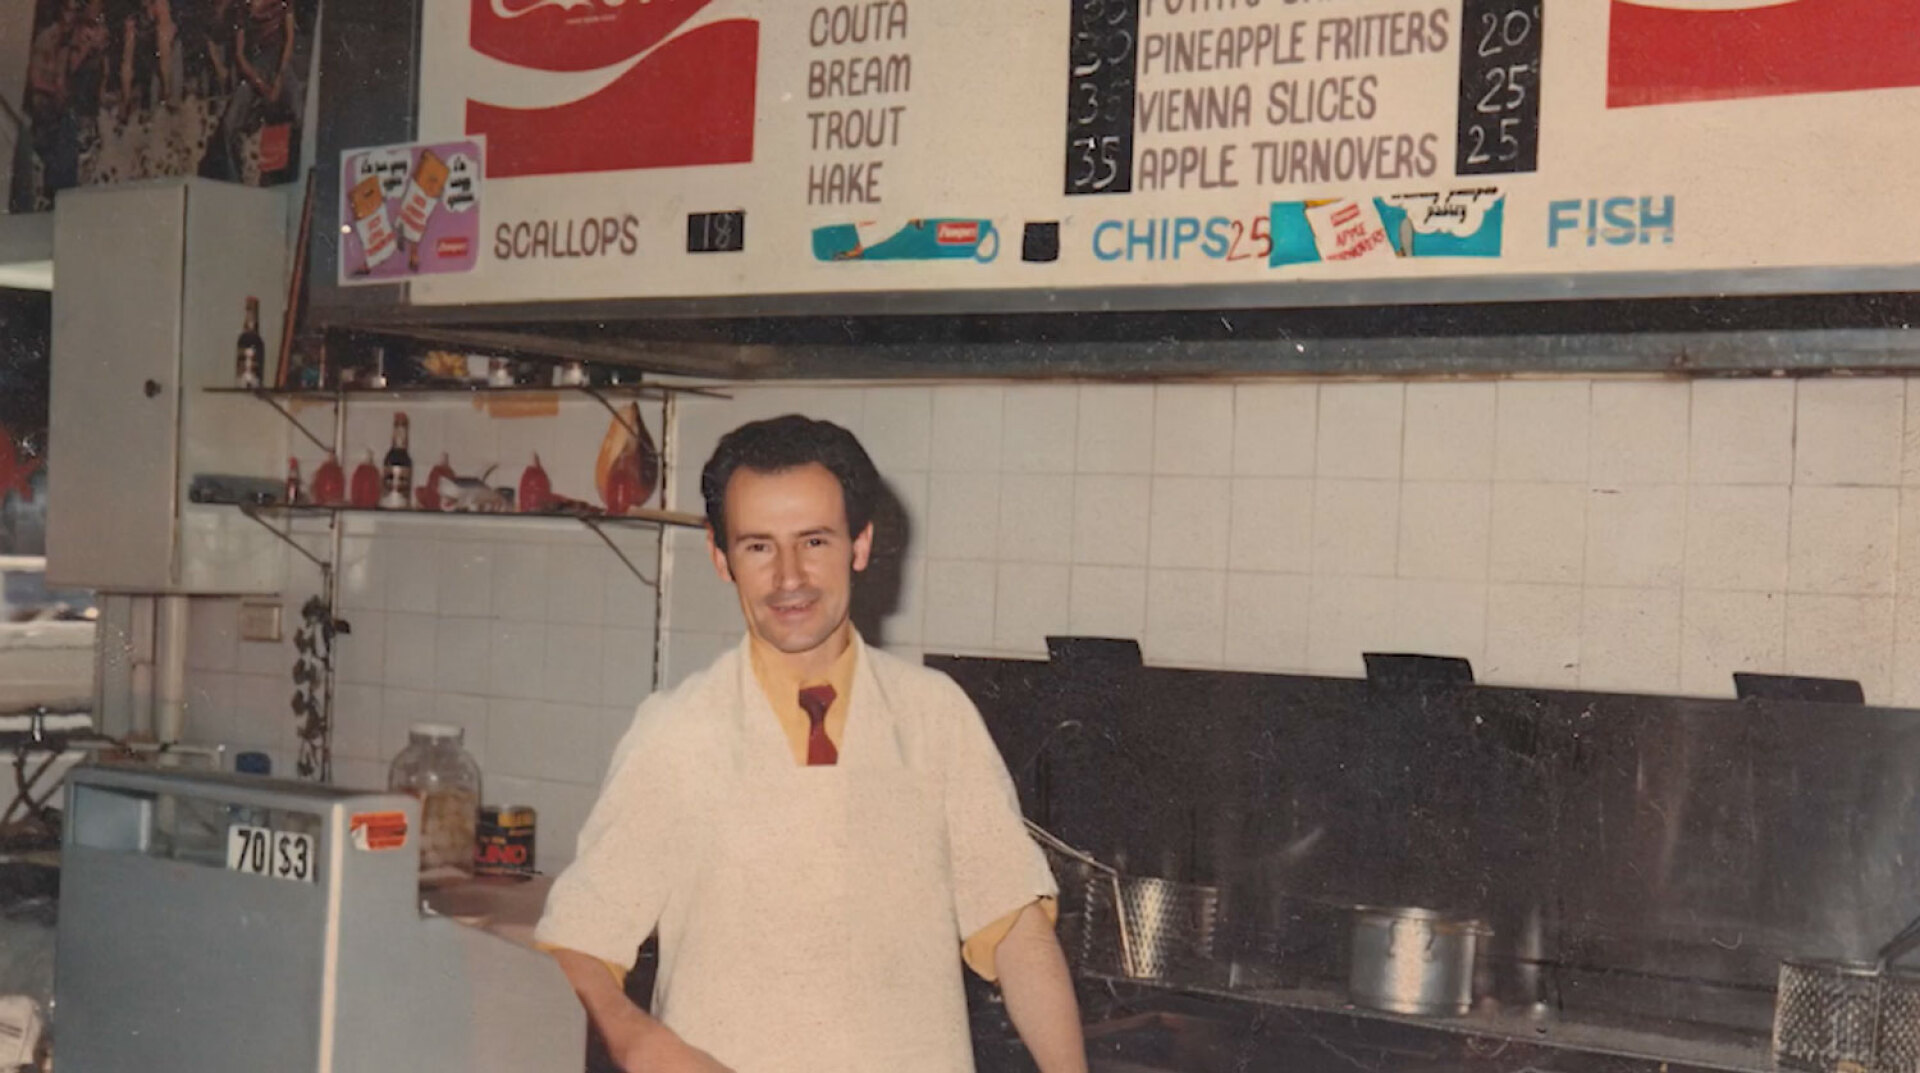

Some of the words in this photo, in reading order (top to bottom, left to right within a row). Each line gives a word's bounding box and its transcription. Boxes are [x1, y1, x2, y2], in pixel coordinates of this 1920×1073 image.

[809, 0, 908, 47] COUTA
[1142, 20, 1307, 75] PINEAPPLE
[1315, 8, 1450, 62] FRITTERS
[808, 53, 912, 99] BREAM
[1138, 83, 1252, 134] VIENNA
[1266, 74, 1379, 126] SLICES
[806, 105, 907, 151] TROUT
[1466, 117, 1522, 165] 25
[807, 160, 884, 206] HAKE
[1073, 136, 1121, 190] 35
[1138, 144, 1239, 192] APPLE
[1251, 132, 1439, 186] TURNOVERS
[493, 213, 640, 260] SCALLOPS
[1091, 216, 1231, 262] CHIPS
[1225, 215, 1275, 262] 25
[1547, 195, 1676, 249] FISH
[237, 830, 266, 872] 70
